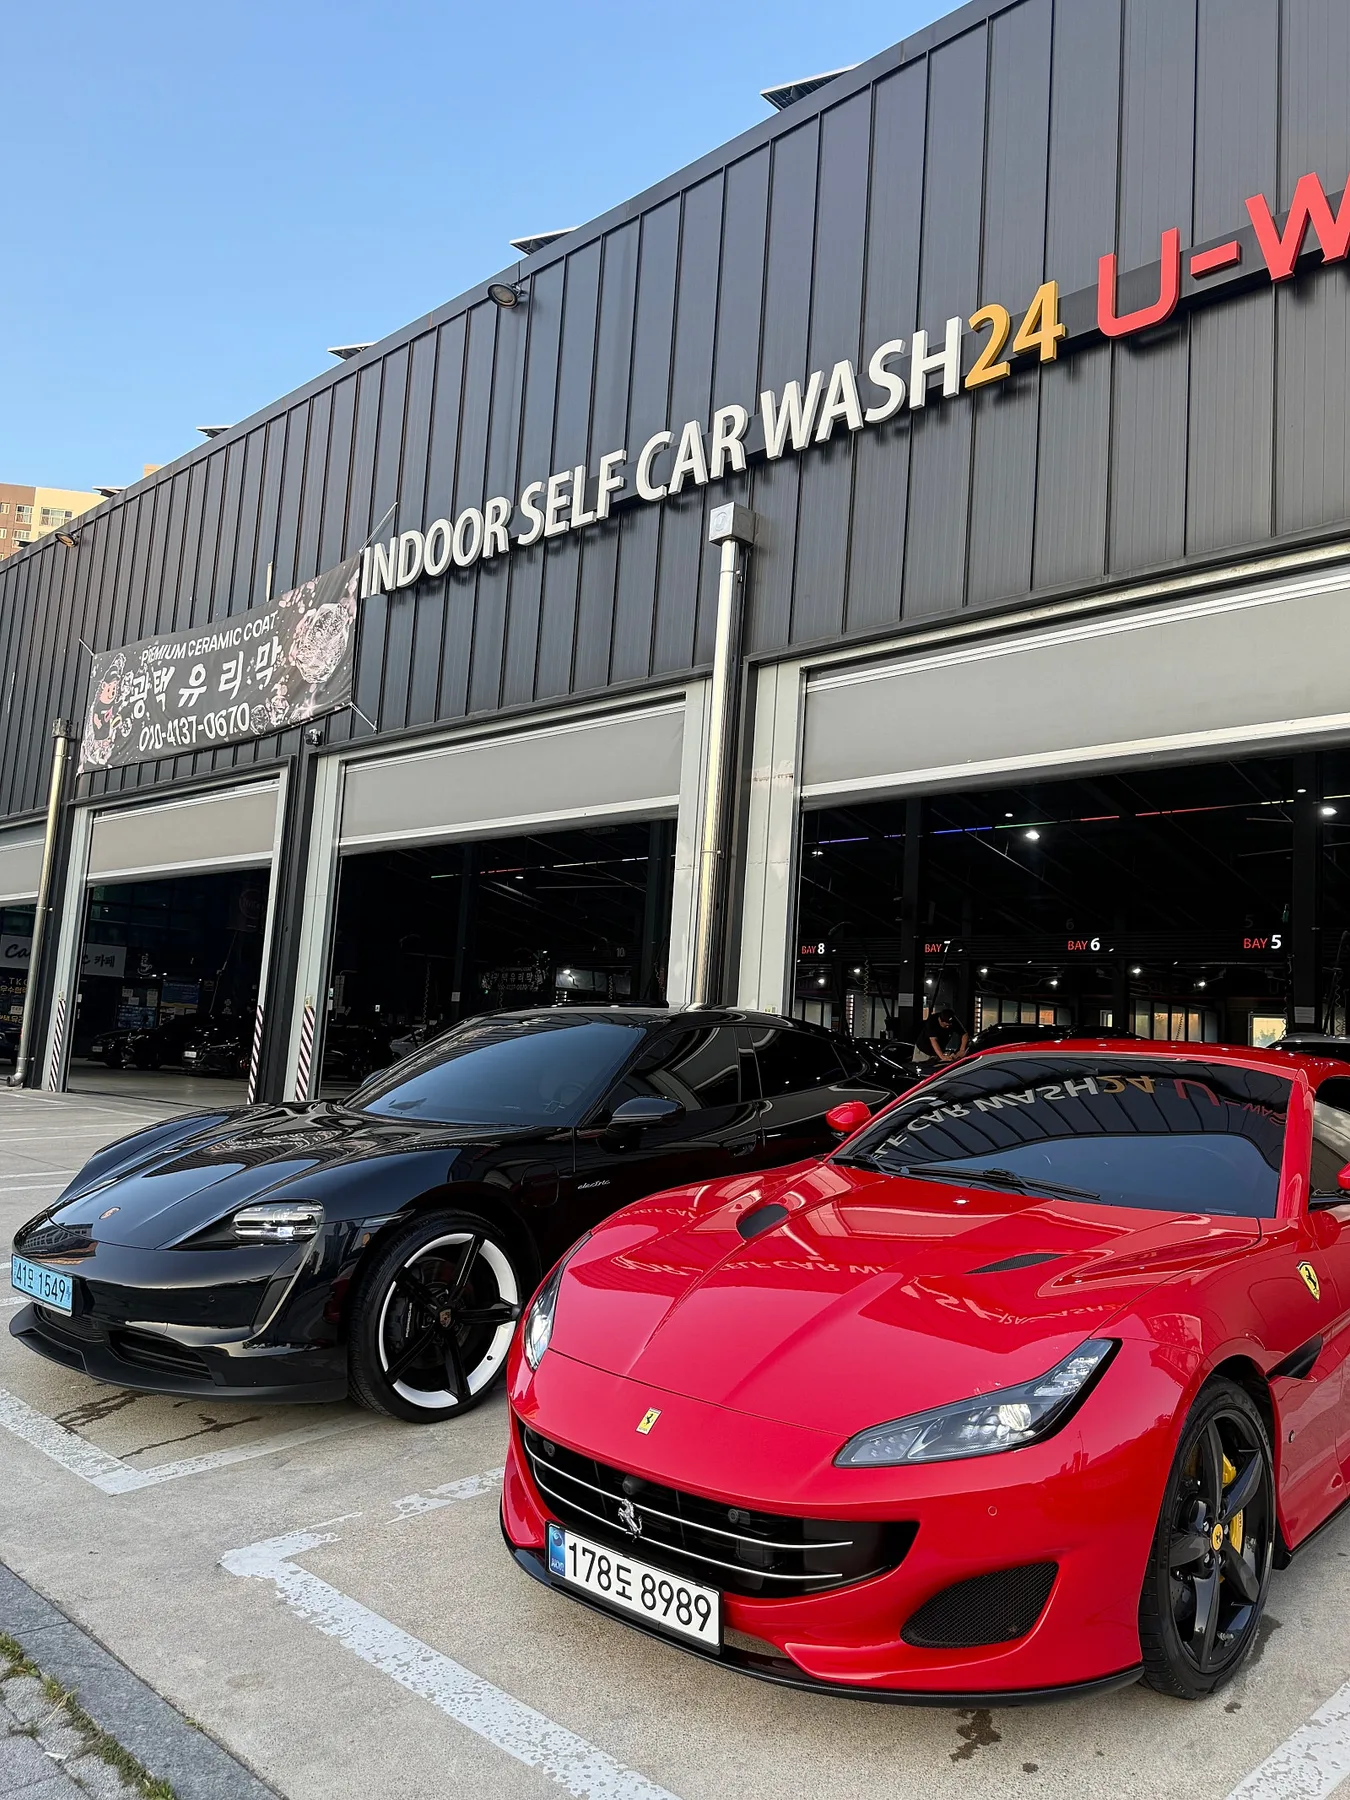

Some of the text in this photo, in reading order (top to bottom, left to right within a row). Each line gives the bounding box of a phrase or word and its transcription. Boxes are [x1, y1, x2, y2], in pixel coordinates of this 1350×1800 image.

[361, 496, 512, 599] INDOOR
[517, 449, 627, 546] SELF
[635, 404, 747, 501] CAR
[188, 627, 243, 656] CERAMIC
[139, 702, 250, 752] 010-4137-0670
[801, 943, 825, 954] BAY 8
[924, 943, 942, 953] BAY
[1067, 938, 1100, 951] BAY 6
[1242, 934, 1282, 949] BAY 5
[38, 1271, 66, 1303] 1549
[568, 1541, 712, 1632] 178도 8989
